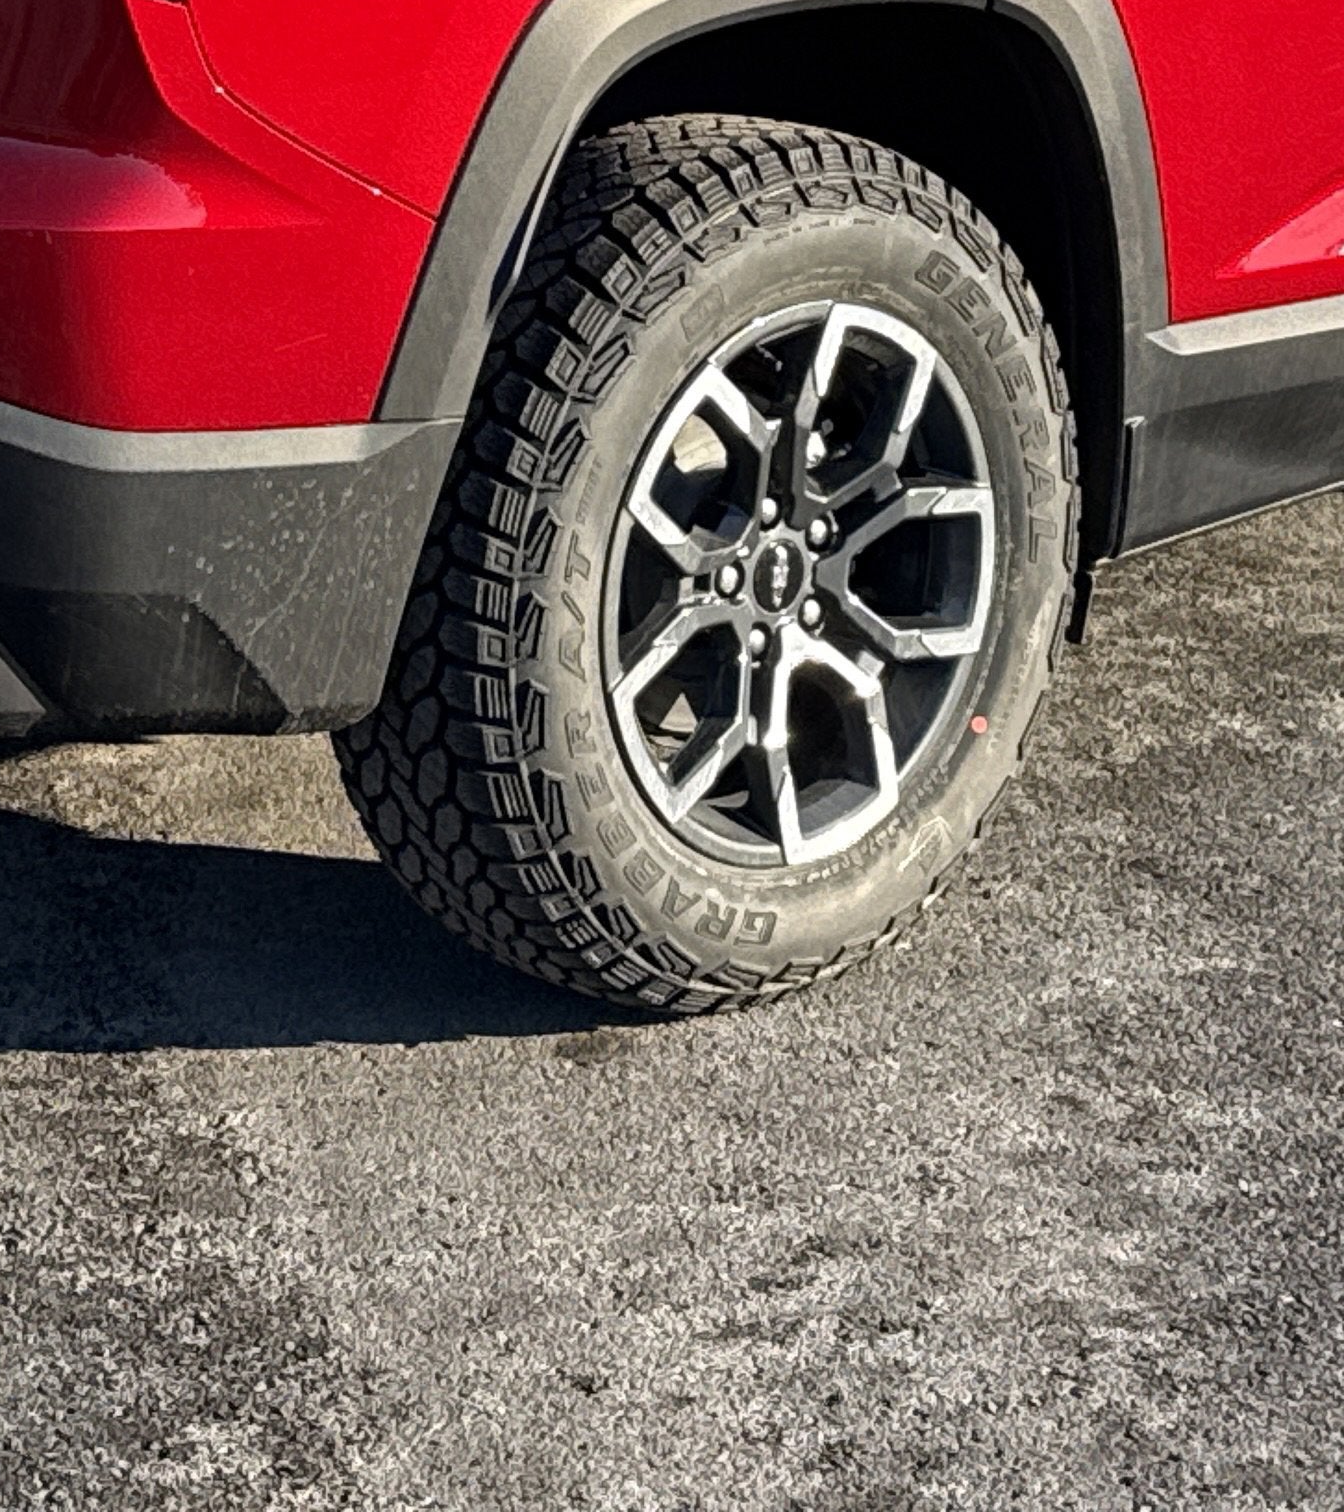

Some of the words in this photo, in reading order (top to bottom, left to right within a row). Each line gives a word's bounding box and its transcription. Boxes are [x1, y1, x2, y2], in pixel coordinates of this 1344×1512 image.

[913, 249, 1058, 564] GENERAL
[558, 528, 591, 683] A/T
[563, 706, 777, 947] GRABBER
